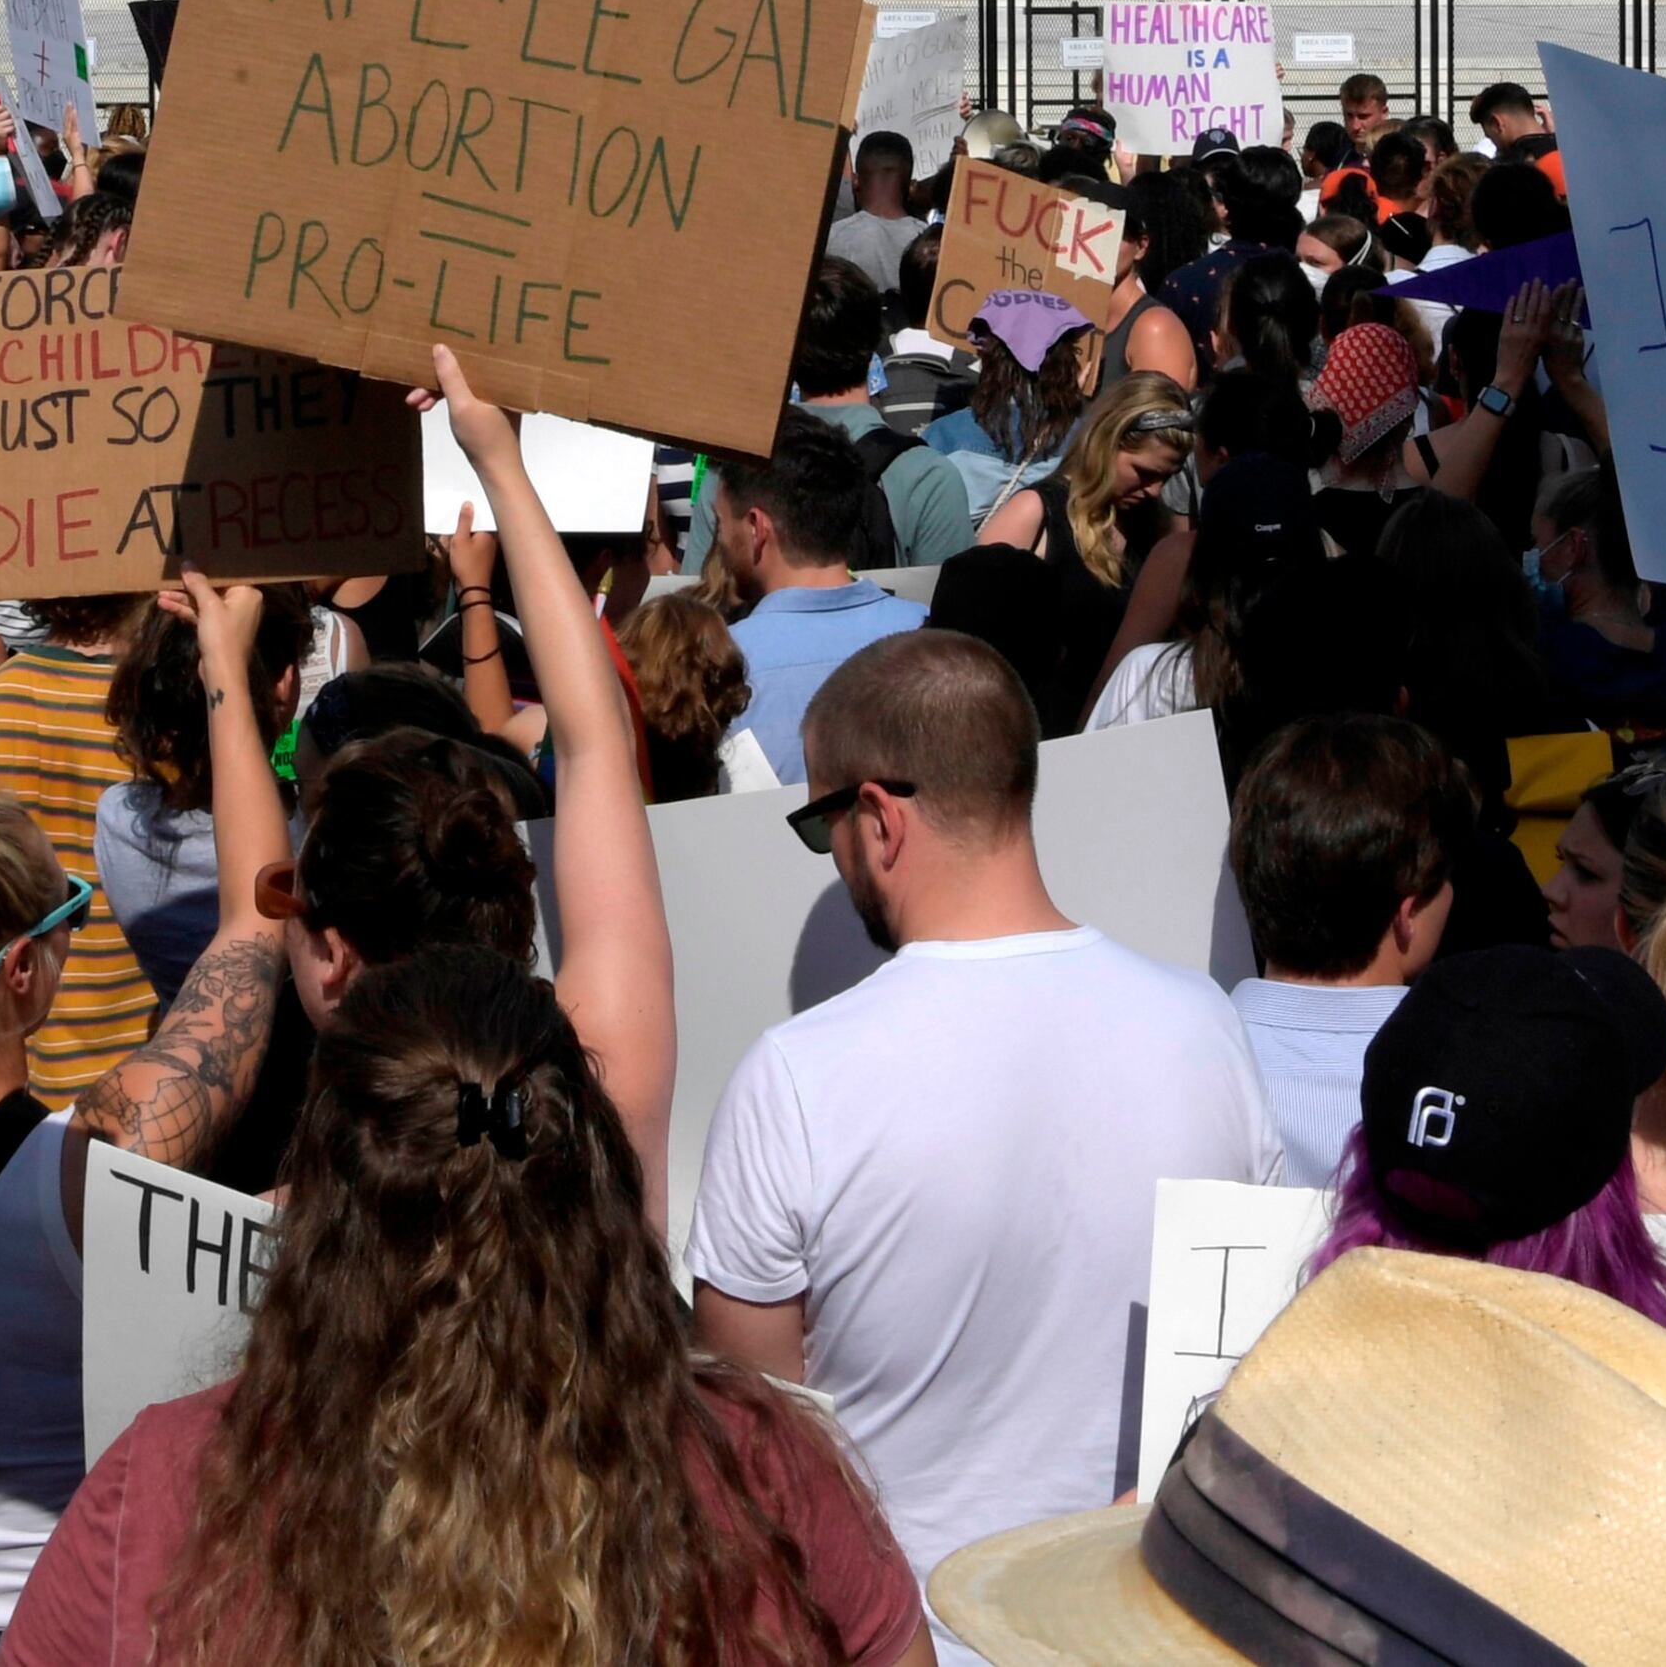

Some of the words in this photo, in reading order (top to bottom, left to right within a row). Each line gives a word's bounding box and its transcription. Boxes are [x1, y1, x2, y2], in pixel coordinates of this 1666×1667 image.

[883, 14, 901, 22] AREA
[903, 14, 931, 22] CLOSED
[1110, 3, 1271, 45] HEALTHCARE
[1187, 49, 1205, 68] IS
[1212, 48, 1230, 69] A
[1108, 72, 1211, 108] HUMAN
[277, 52, 702, 232] ABORTION
[1171, 104, 1265, 142] RIGHT
[965, 170, 1113, 275] FUCK
[244, 212, 611, 365] PRO-LIFE
[994, 245, 1043, 292] the
[107, 387, 181, 446] SO
[202, 369, 358, 439] THEY
[115, 483, 202, 556] AT
[208, 464, 407, 551] RECESS
